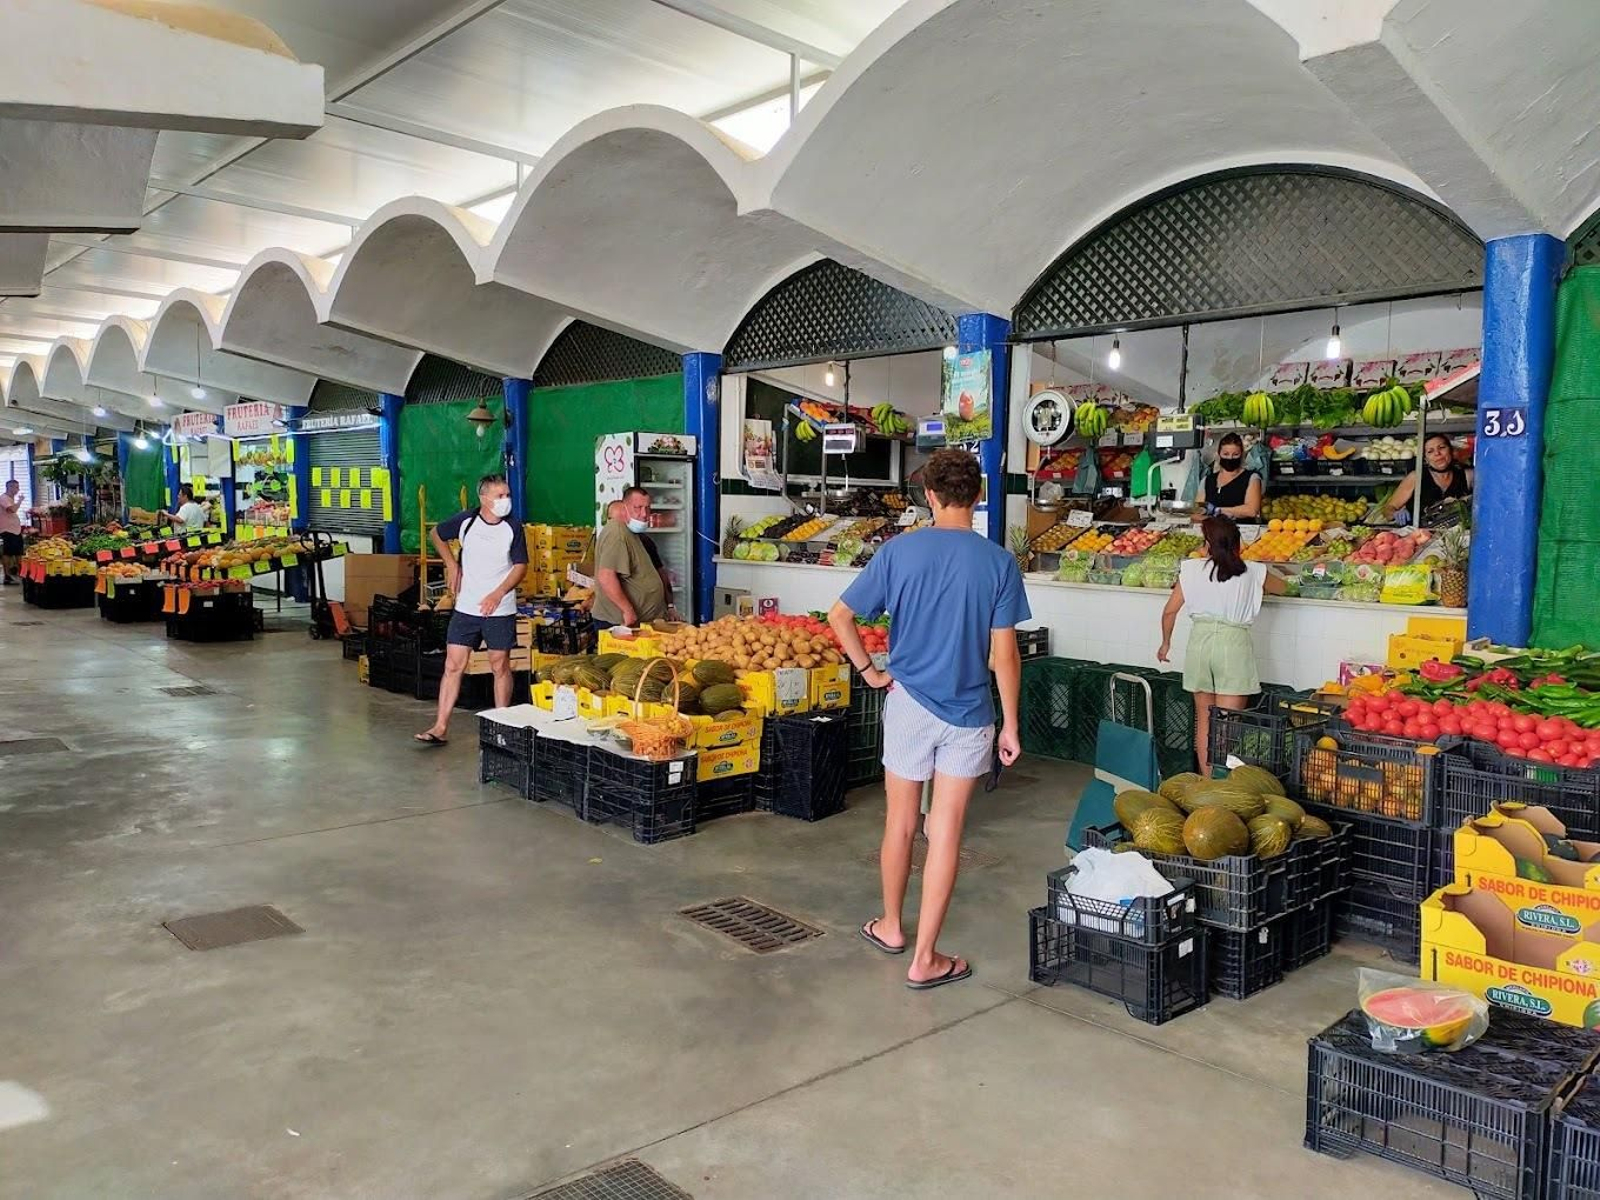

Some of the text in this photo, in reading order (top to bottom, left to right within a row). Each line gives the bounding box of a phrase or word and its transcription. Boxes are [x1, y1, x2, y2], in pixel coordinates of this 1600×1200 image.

[227, 403, 269, 419] FRUTERIA
[1479, 877, 1525, 897] SABOR
[1528, 887, 1547, 902] DE
[1445, 951, 1494, 976] SABOR
[1498, 965, 1517, 982] DE
[1522, 971, 1597, 998] CHIPIONA
